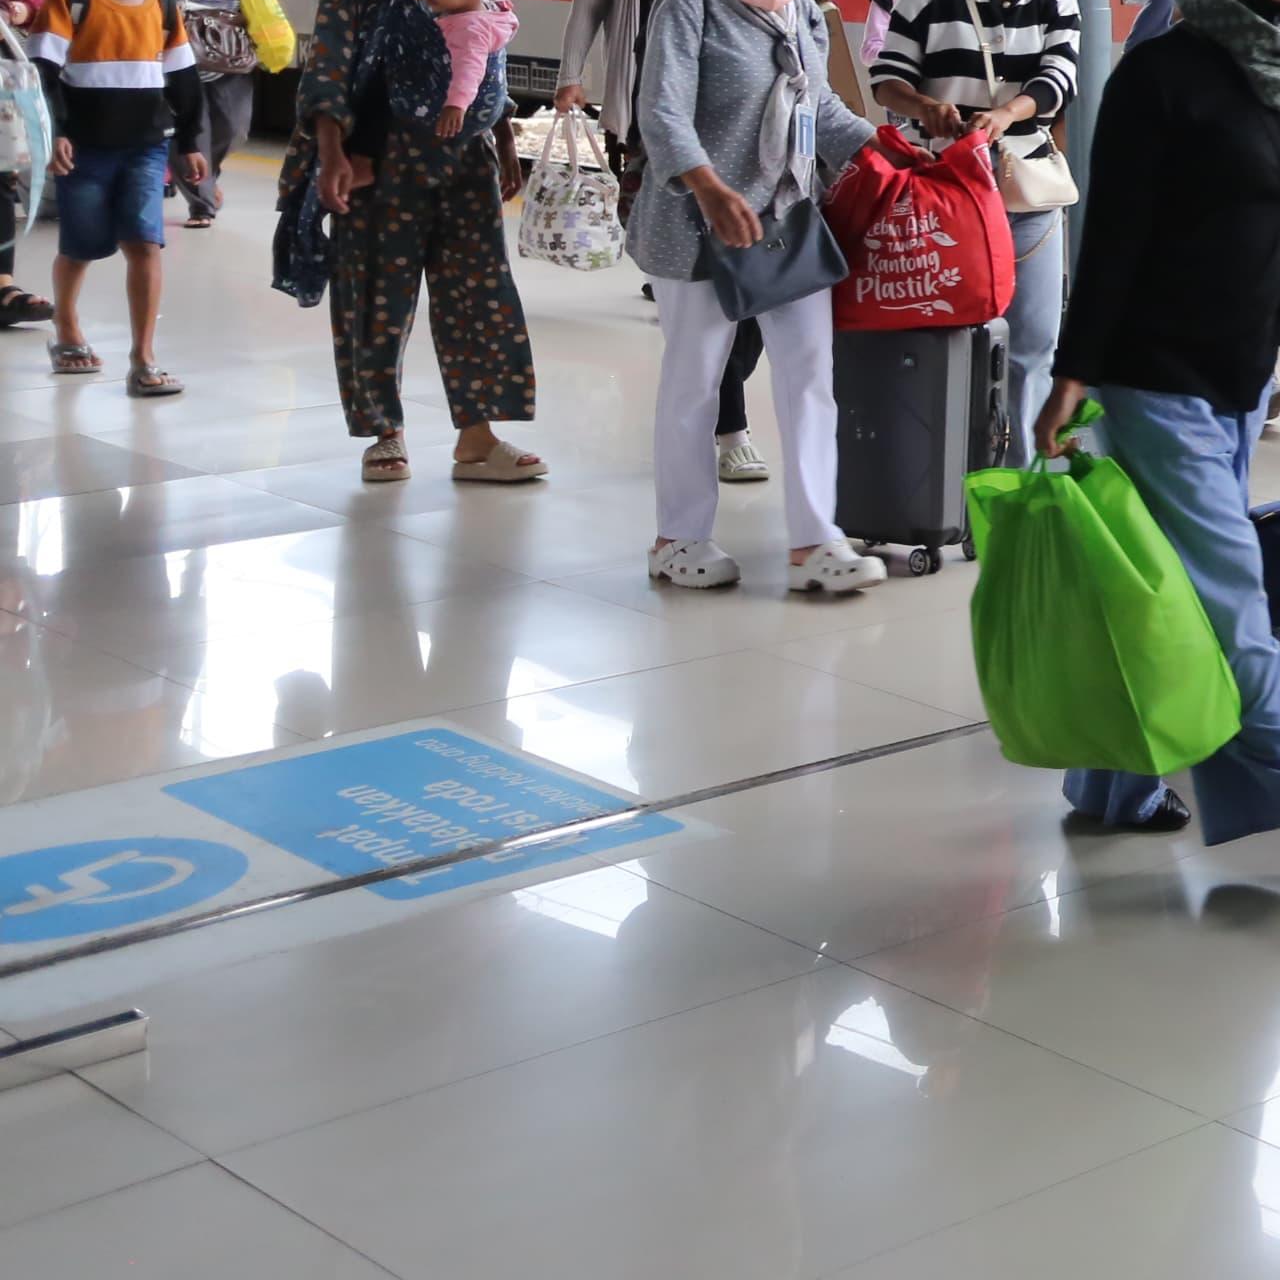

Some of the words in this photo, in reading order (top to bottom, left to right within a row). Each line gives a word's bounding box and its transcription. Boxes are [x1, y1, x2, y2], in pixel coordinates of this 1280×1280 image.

[905, 210, 941, 236] Asik
[867, 250, 941, 274] Kantong
[855, 271, 940, 304] Plastik
[421, 779, 512, 814] roda
[477, 809, 591, 851] krsi
[314, 824, 453, 886] Tmpat
